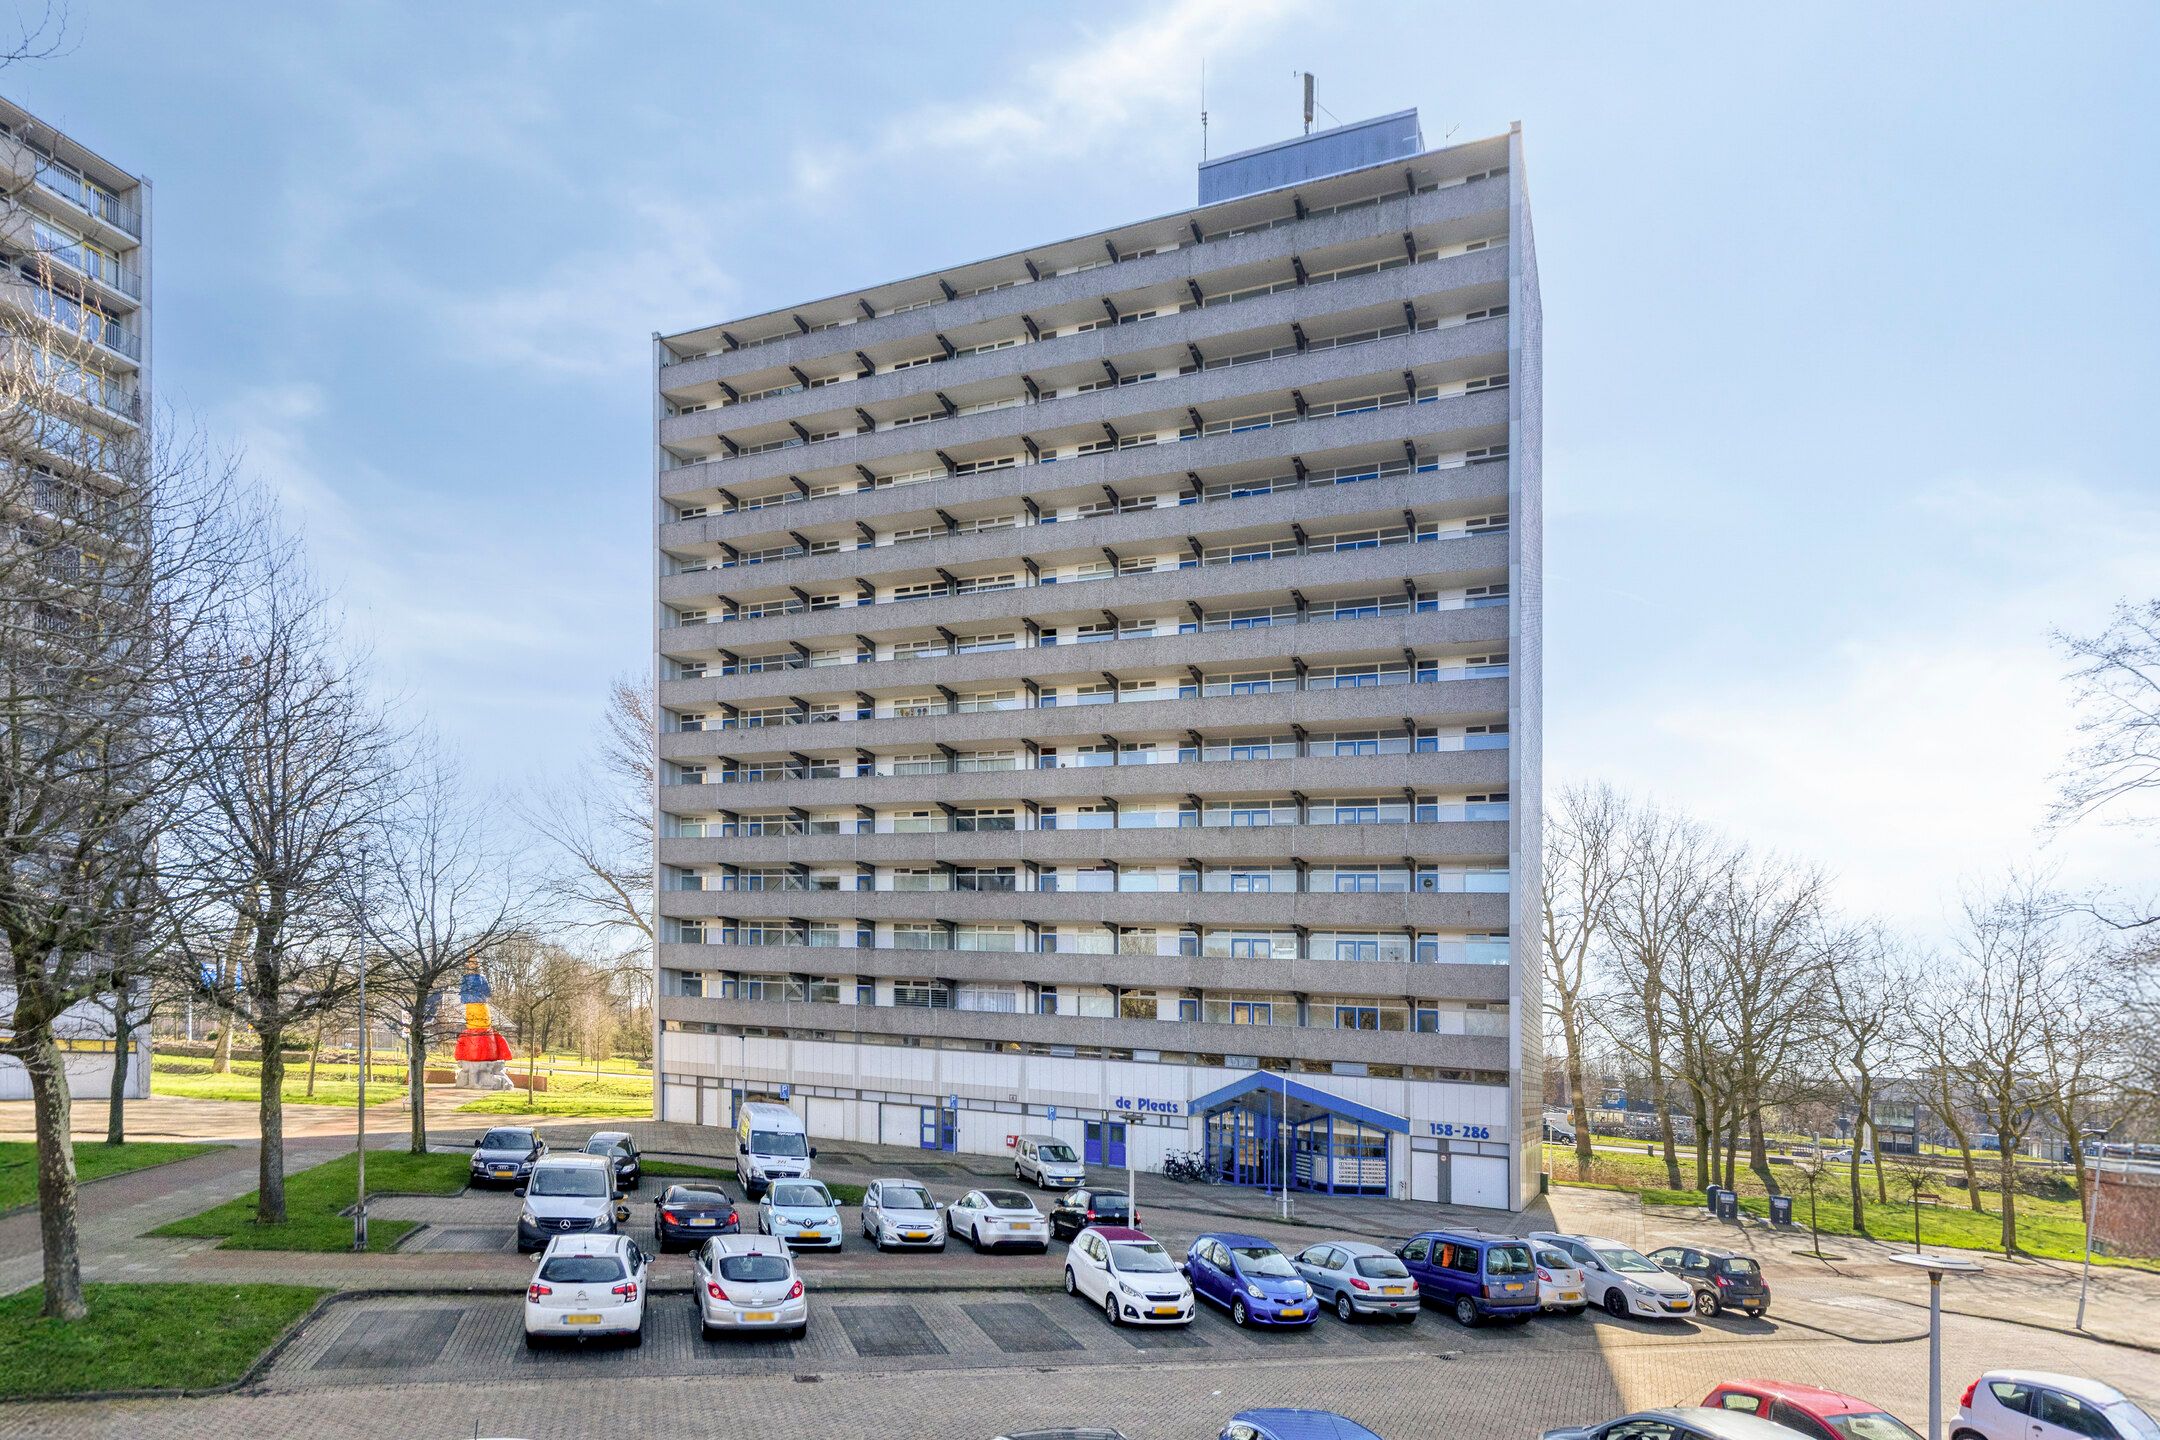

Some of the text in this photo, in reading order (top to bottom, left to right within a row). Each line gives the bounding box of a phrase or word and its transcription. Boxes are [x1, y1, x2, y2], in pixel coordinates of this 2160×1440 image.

[1116, 1096, 1178, 1113] de Pleats
[1430, 1123, 1489, 1139] 158-286
